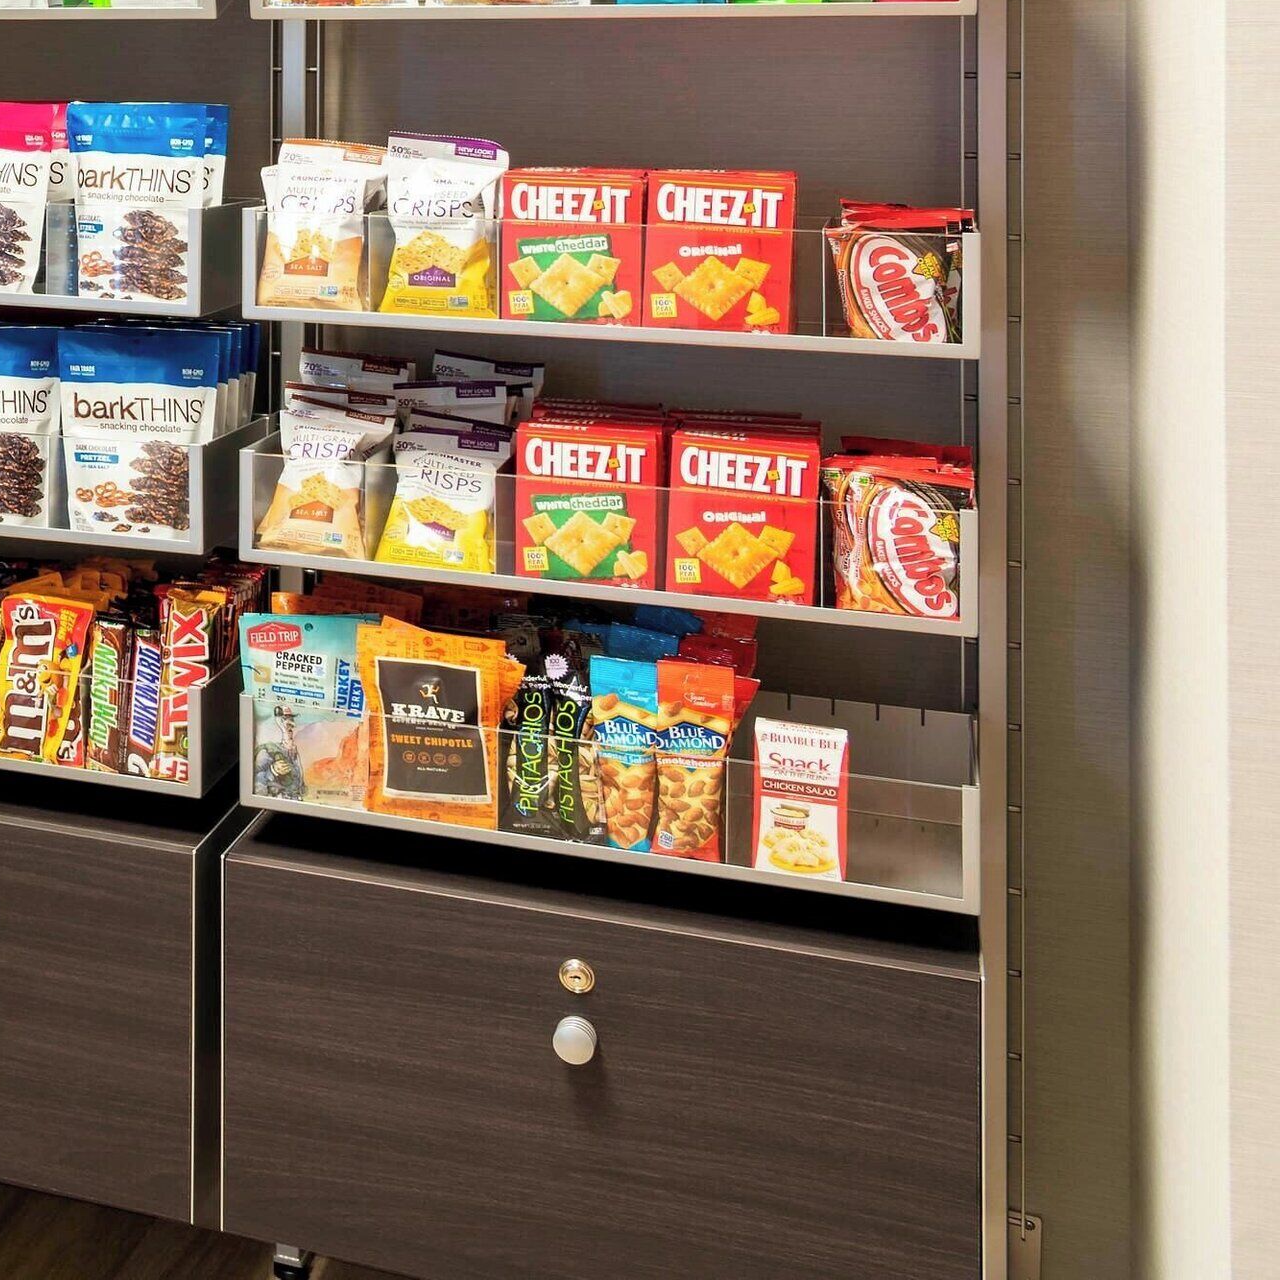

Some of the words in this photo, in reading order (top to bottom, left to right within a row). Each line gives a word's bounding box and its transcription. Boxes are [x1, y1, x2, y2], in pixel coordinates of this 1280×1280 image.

[87, 192, 124, 203] snacking
[125, 194, 165, 204] chocolate
[393, 196, 475, 218] CRISPS
[413, 274, 452, 283] ORIGINAL
[73, 392, 203, 424] barkTHINS
[99, 422, 138, 434] snacking
[139, 423, 182, 434] chocolate
[80, 453, 112, 463] PRETZEL
[250, 630, 277, 644] FIELD
[278, 630, 300, 643] TRIP
[275, 651, 323, 666] CRACKED
[162, 609, 210, 740] TWIX
[275, 660, 314, 674] PEPPER
[391, 702, 466, 723] KRAVE
[605, 721, 641, 736] BLUE
[668, 726, 706, 740] BLUE
[390, 733, 422, 746] SWEET
[424, 736, 474, 749] CHIPOTLE
[770, 732, 816, 748] BUMBLE
[819, 738, 841, 750] BEE
[519, 690, 543, 813] PISTACHIOS
[557, 699, 577, 825] PISTACHIOS
[656, 756, 724, 769] Smokehouse
[768, 751, 831, 771] Snack
[762, 779, 804, 794] CHICKEN
[804, 784, 837, 799] SALAD
